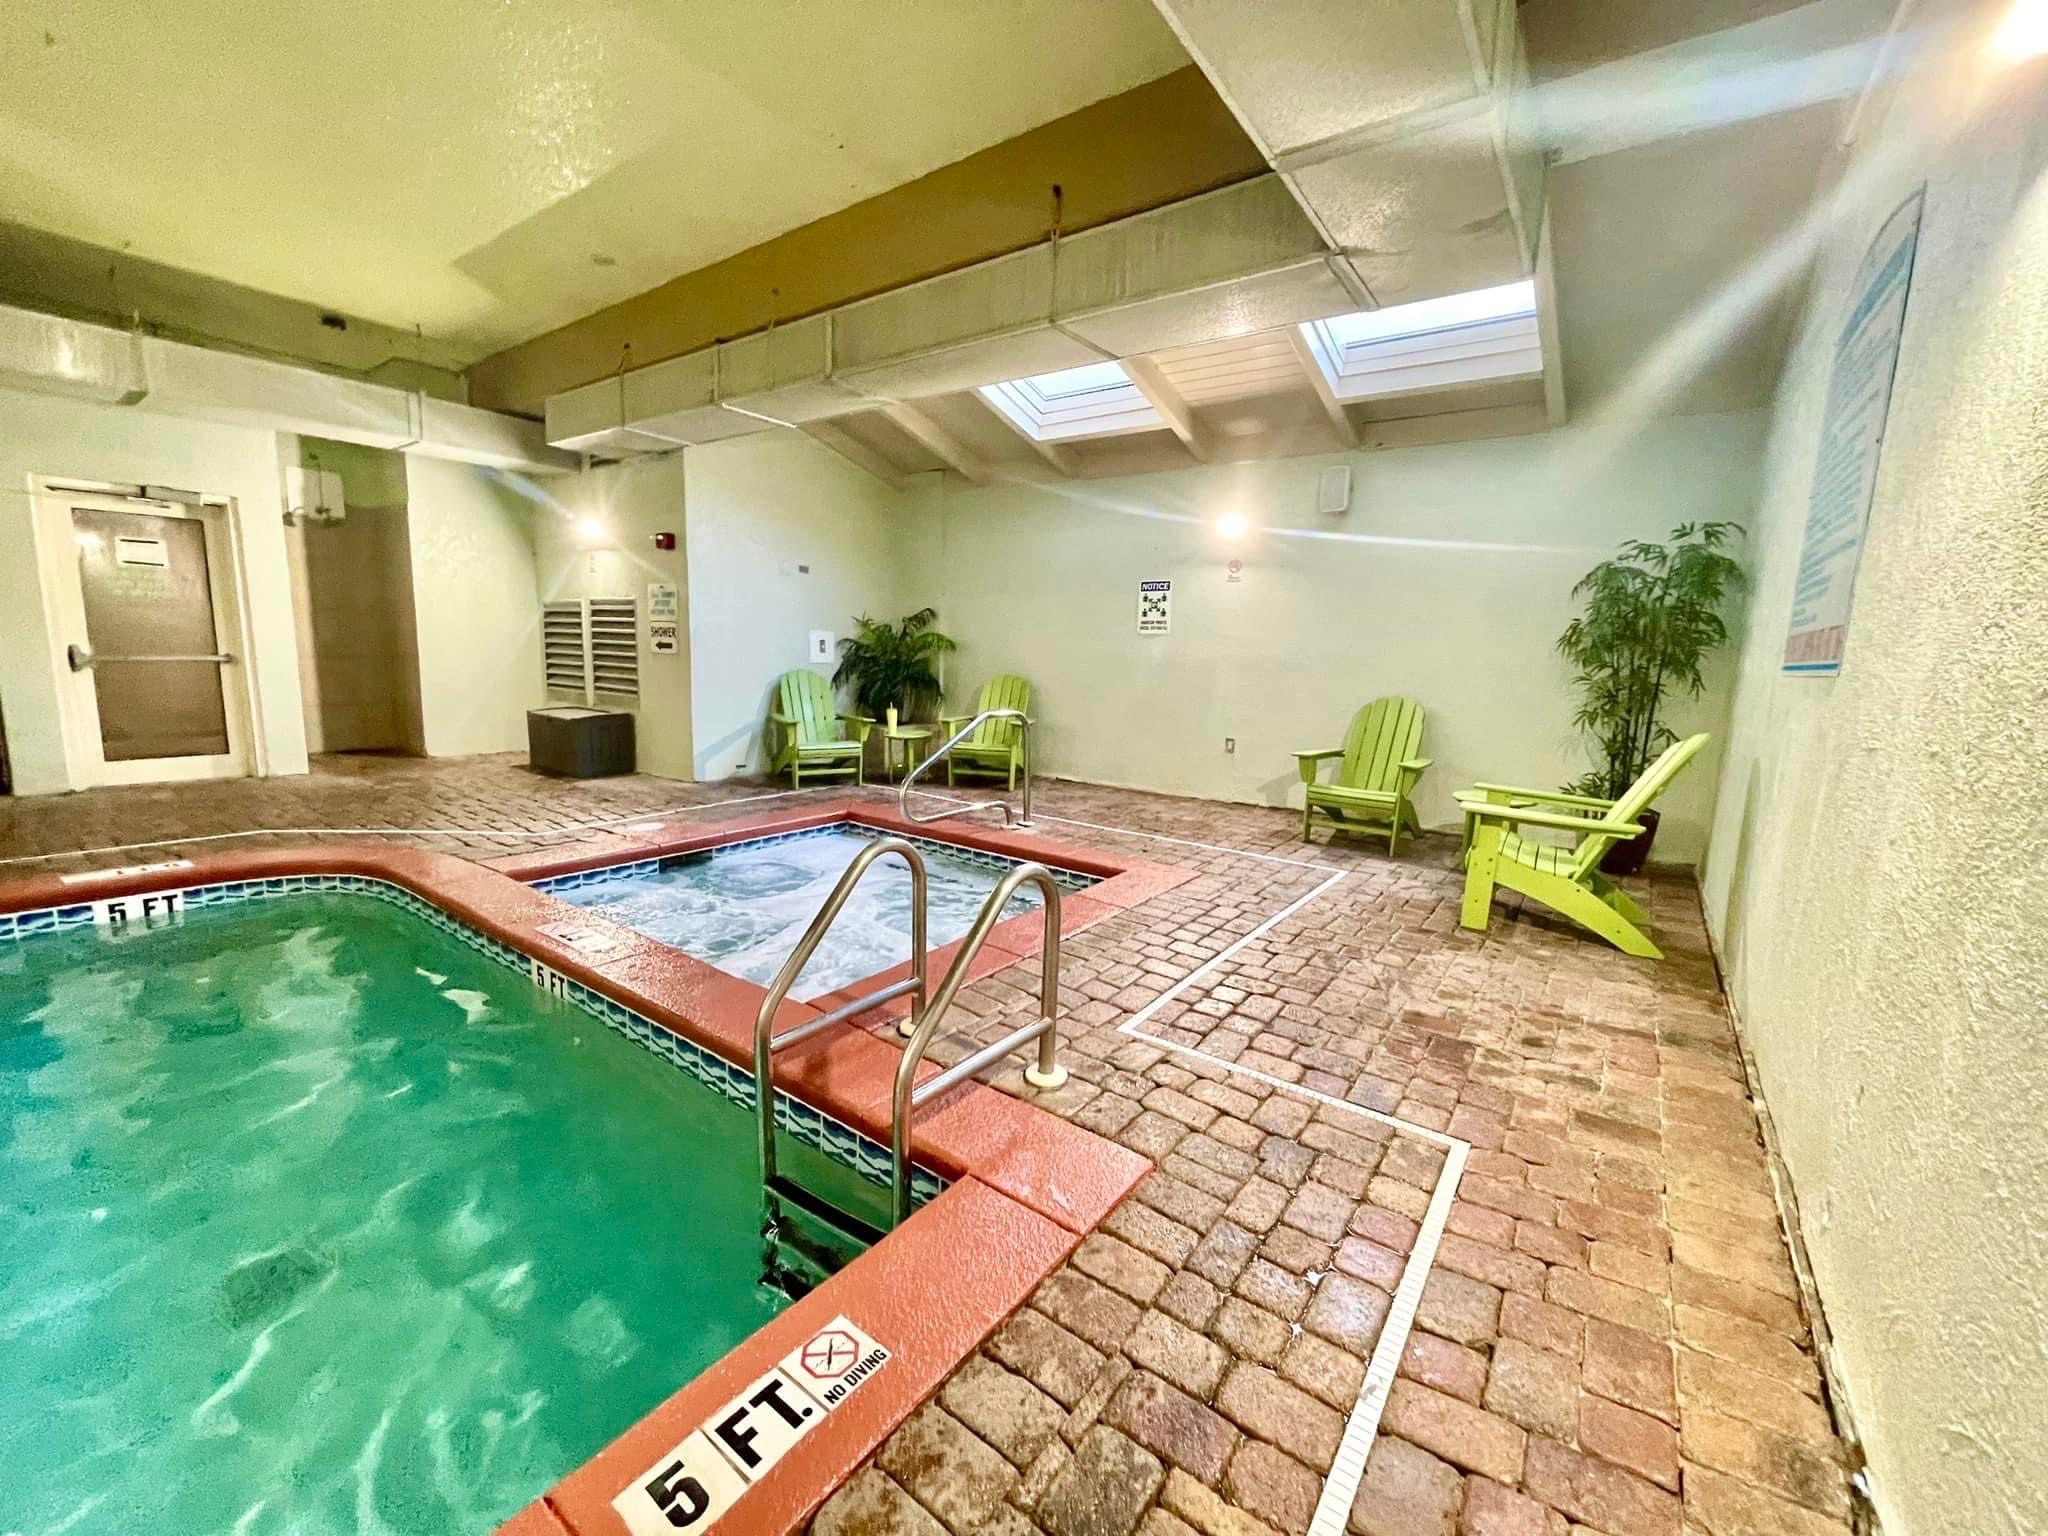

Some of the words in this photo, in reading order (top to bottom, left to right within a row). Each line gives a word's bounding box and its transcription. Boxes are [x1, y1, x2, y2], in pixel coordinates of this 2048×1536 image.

[1142, 582, 1169, 591] NOTICE
[650, 626, 677, 638] SHOWER
[142, 894, 178, 917] FT
[536, 964, 545, 987] 5
[550, 971, 565, 999] FT
[823, 1384, 846, 1404] NO
[844, 1349, 887, 1387] DIVING
[645, 1459, 710, 1528] 5
